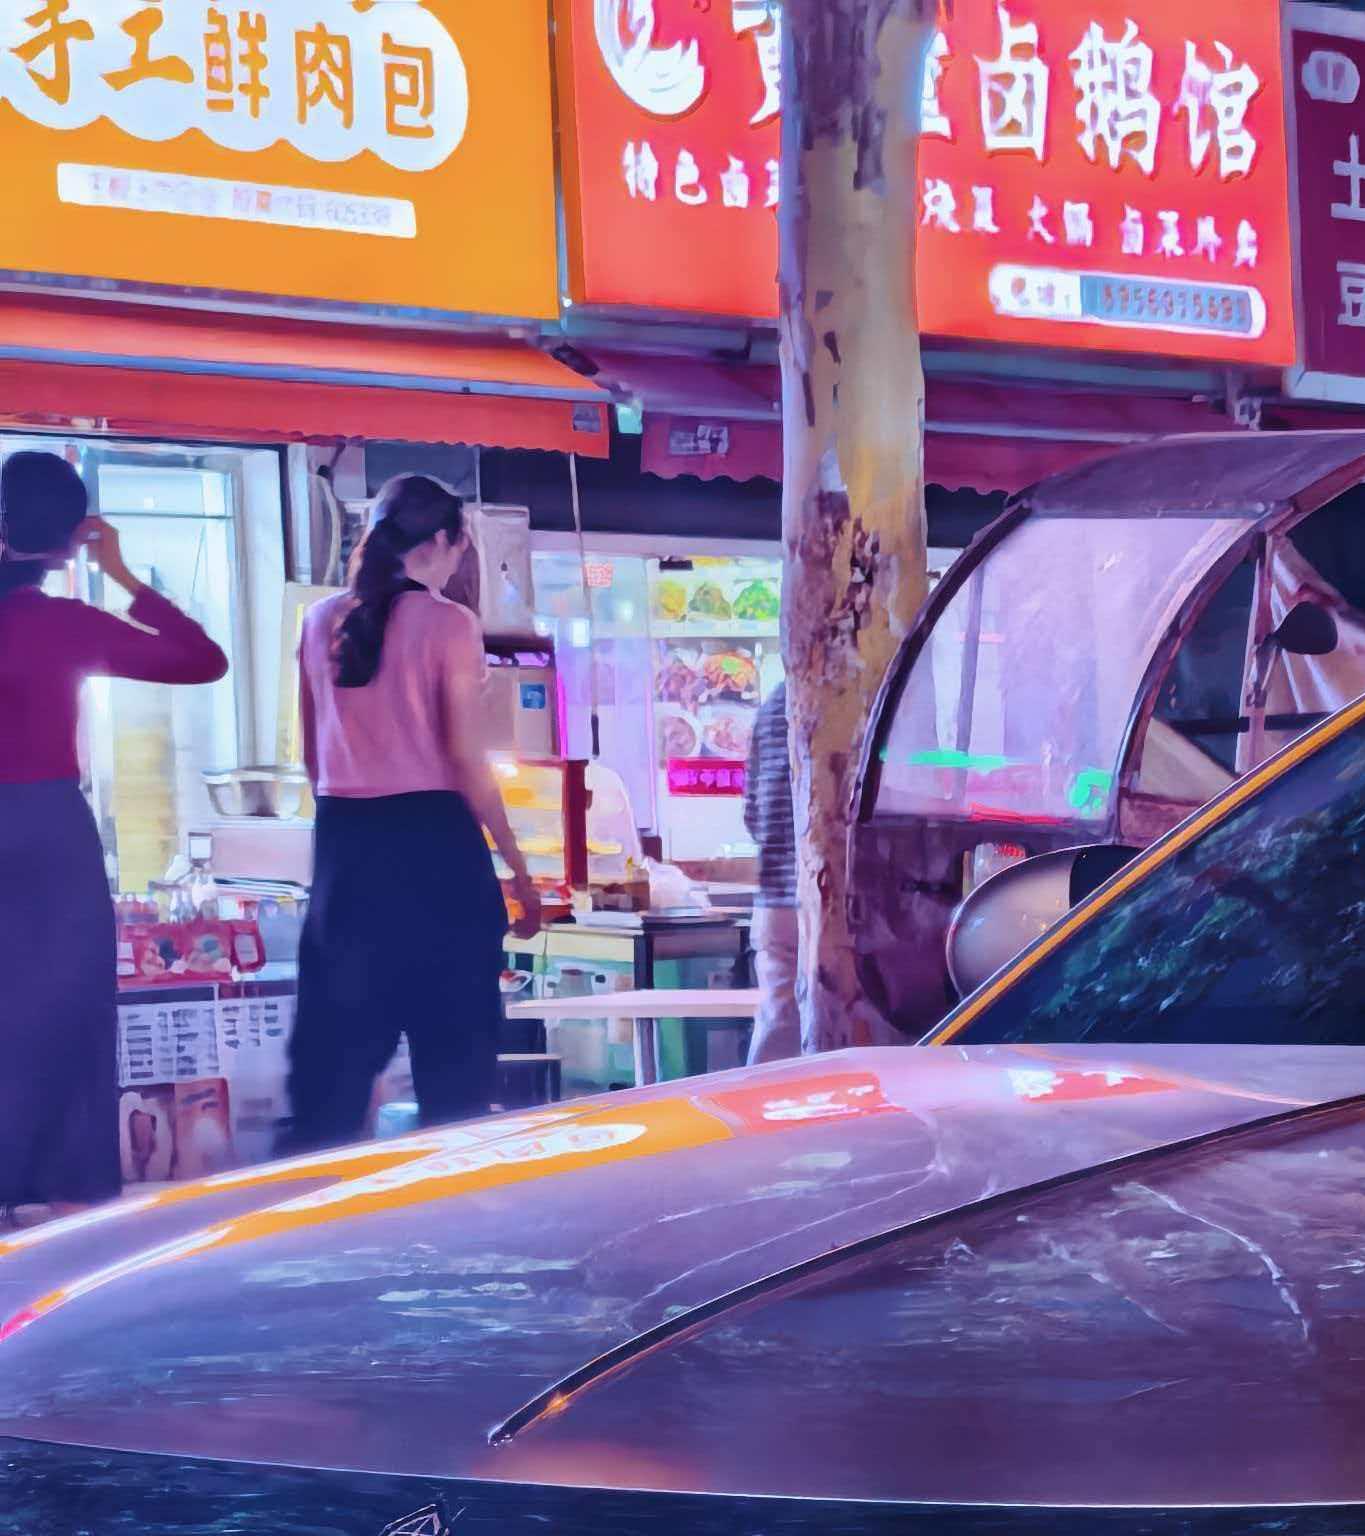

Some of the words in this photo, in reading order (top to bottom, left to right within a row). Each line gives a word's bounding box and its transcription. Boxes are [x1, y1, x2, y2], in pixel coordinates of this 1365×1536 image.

[8, 0, 435, 138] 手工鲜肉包
